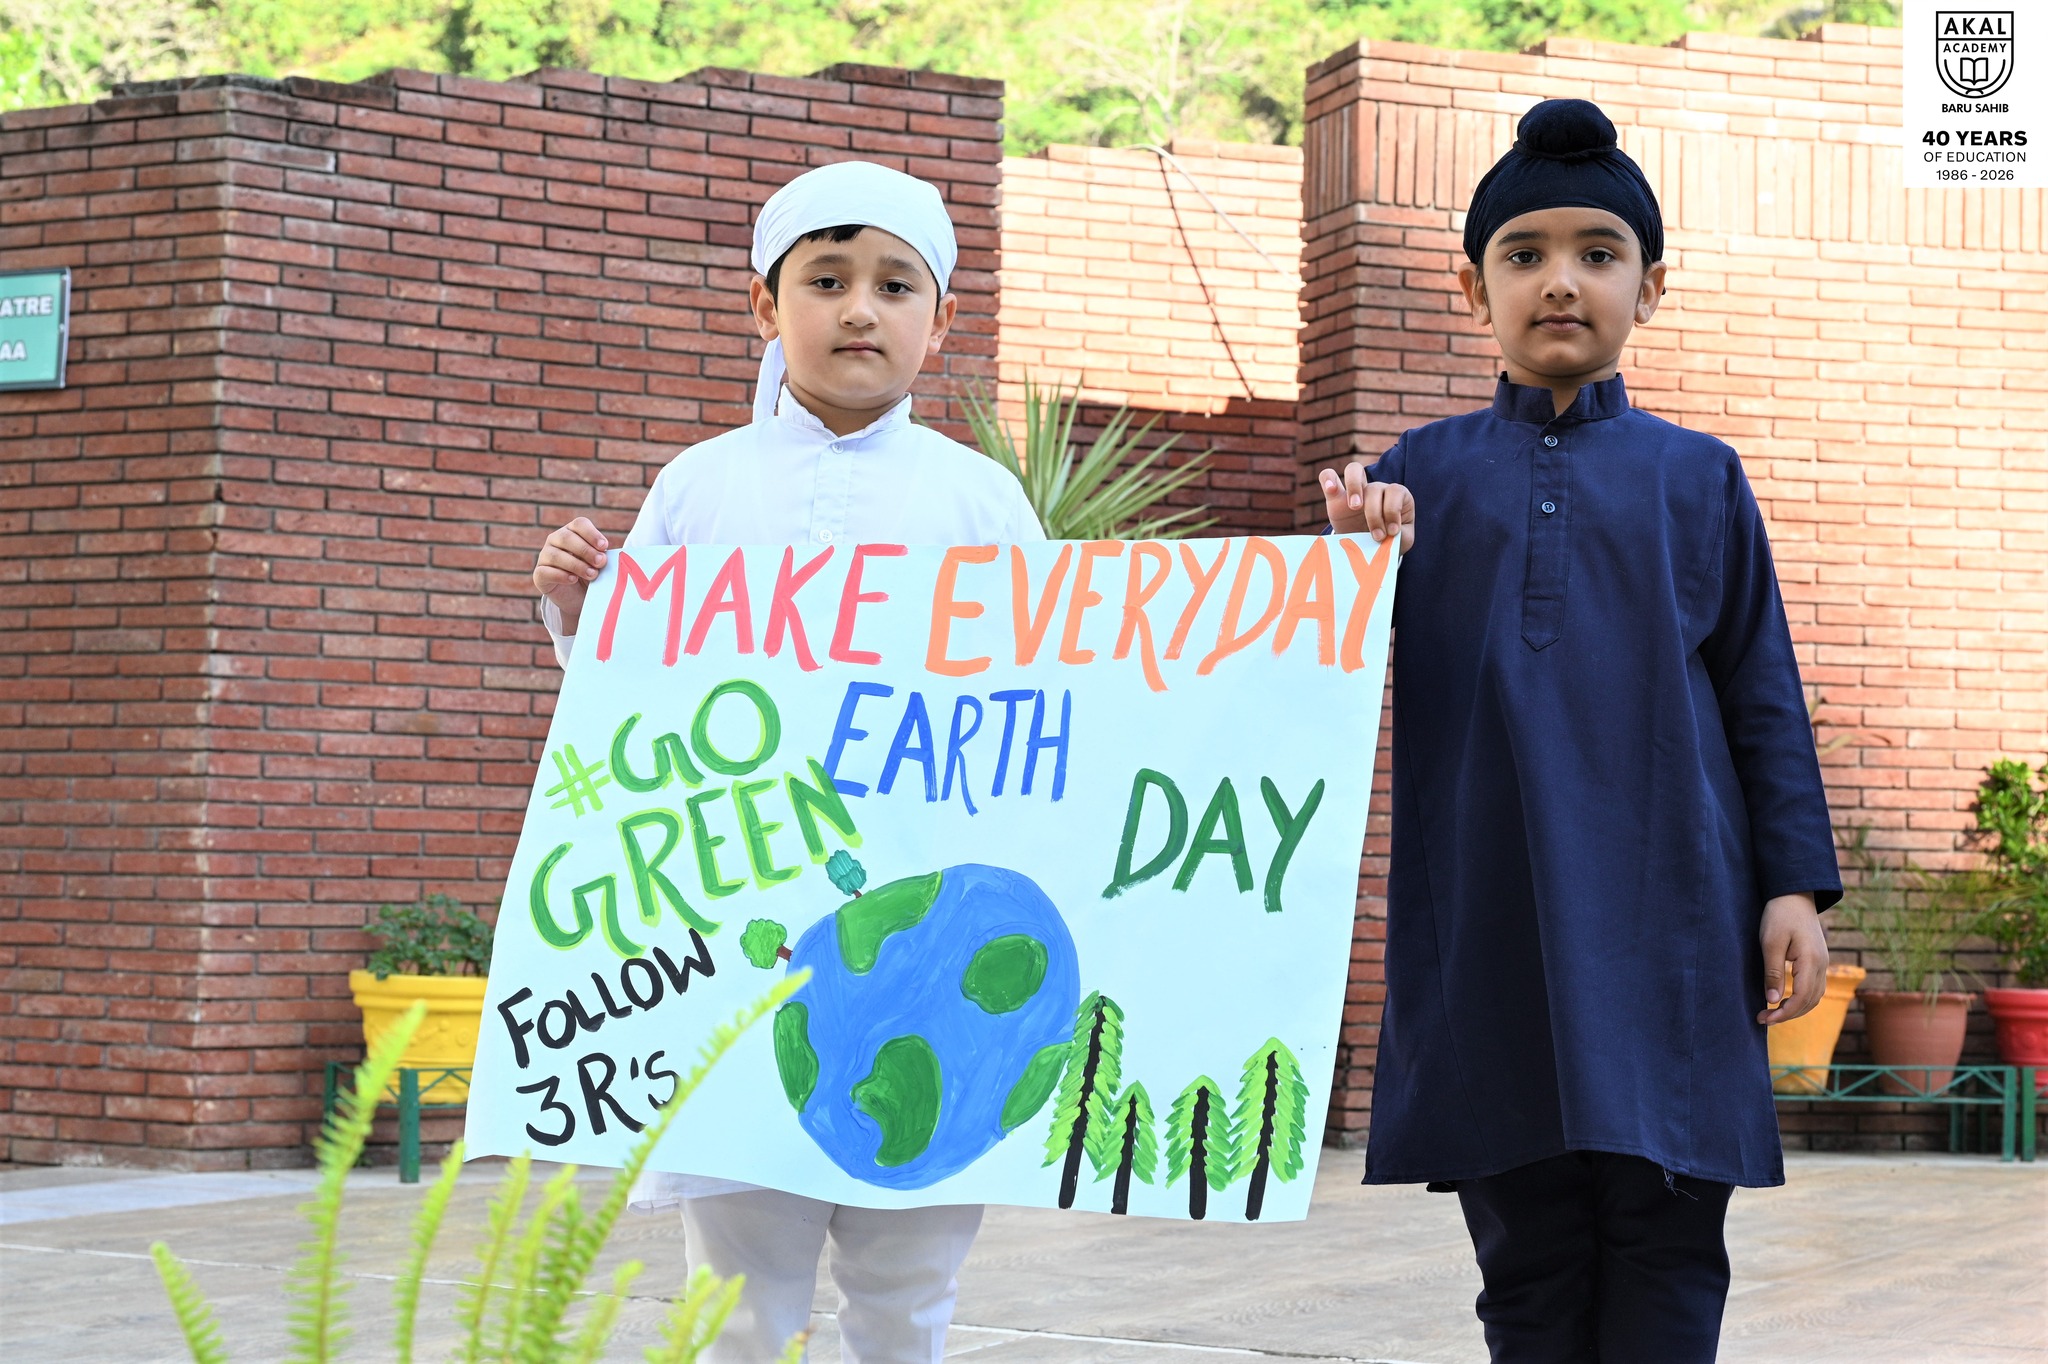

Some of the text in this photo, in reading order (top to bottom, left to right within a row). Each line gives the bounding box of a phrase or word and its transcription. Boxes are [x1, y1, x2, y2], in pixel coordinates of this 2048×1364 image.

[596, 536, 1395, 692] MAKE EVERYDAY
[825, 681, 1072, 817] EARTH
[529, 755, 864, 960] GREEN
[1101, 767, 1326, 914] DAY
[497, 927, 716, 1070] FOLLOW
